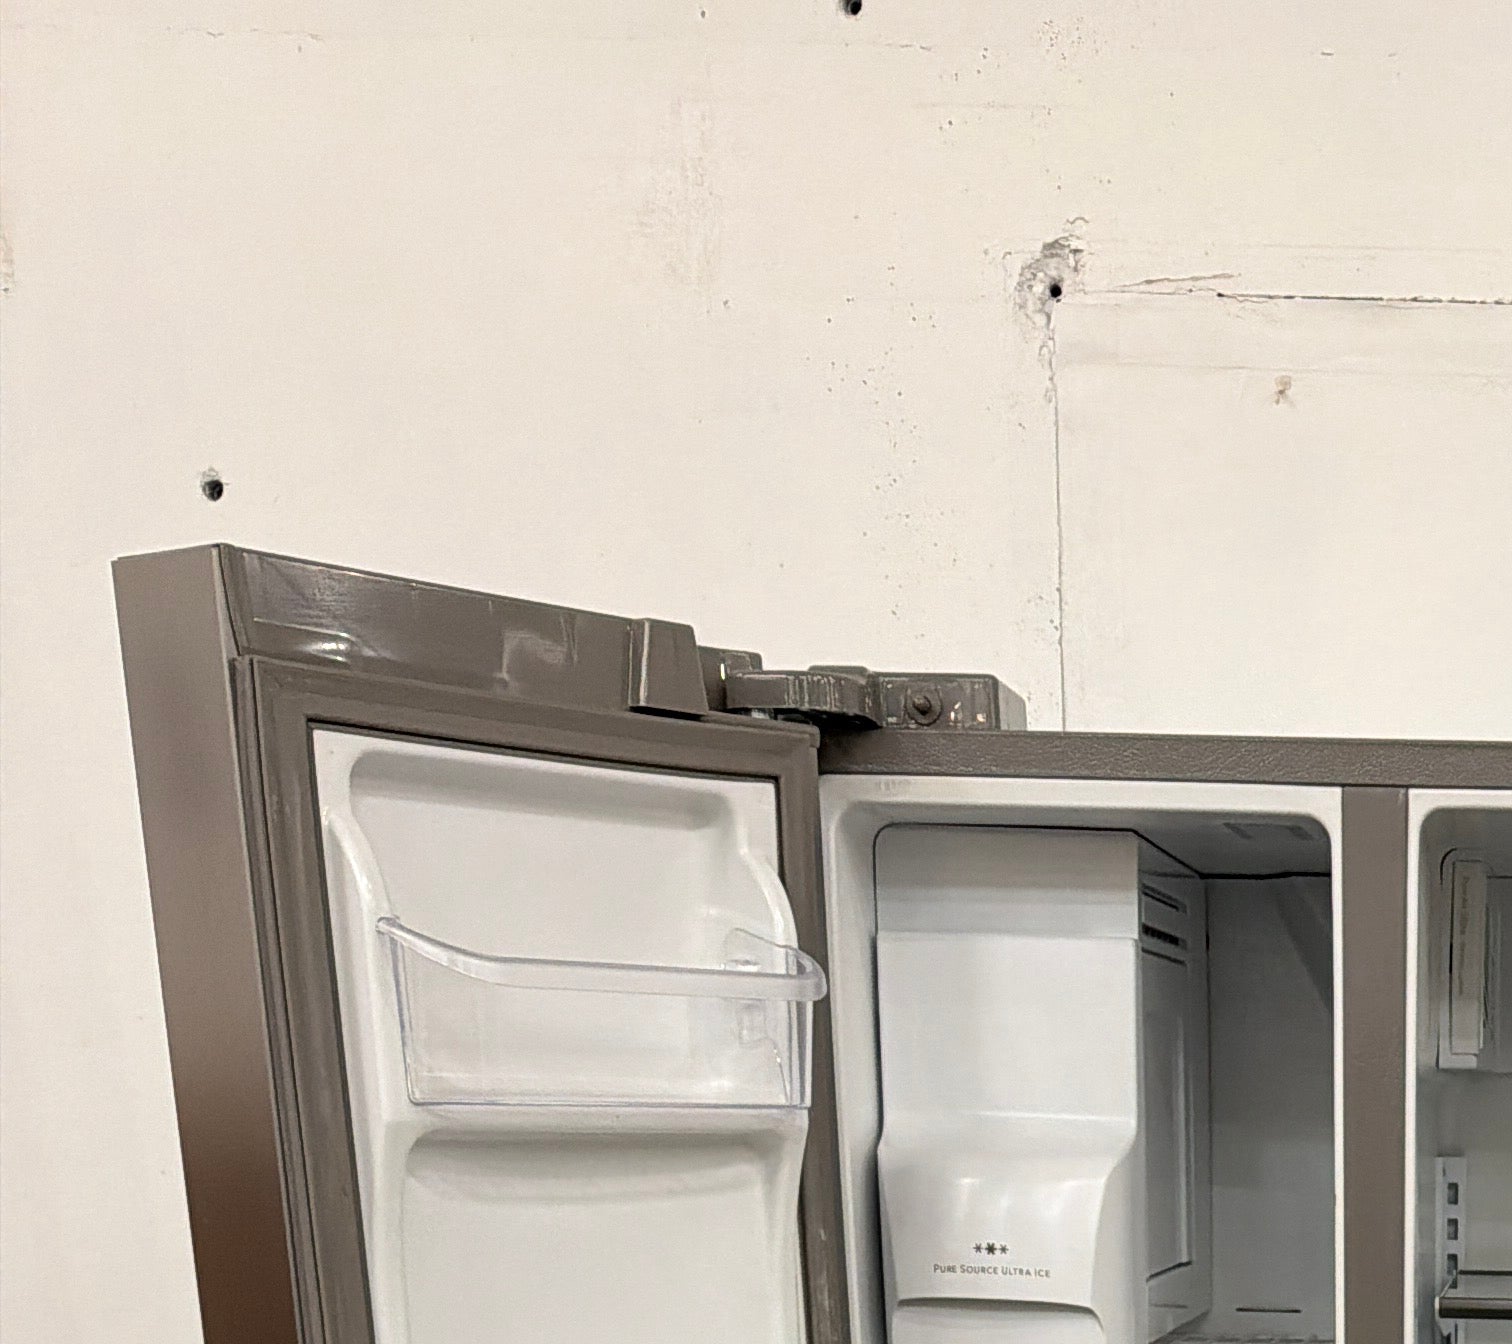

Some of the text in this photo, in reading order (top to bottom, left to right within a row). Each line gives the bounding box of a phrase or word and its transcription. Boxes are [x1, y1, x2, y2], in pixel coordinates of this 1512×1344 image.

[933, 1263, 1051, 1278] PURE SOURCE ULTRA ICE
